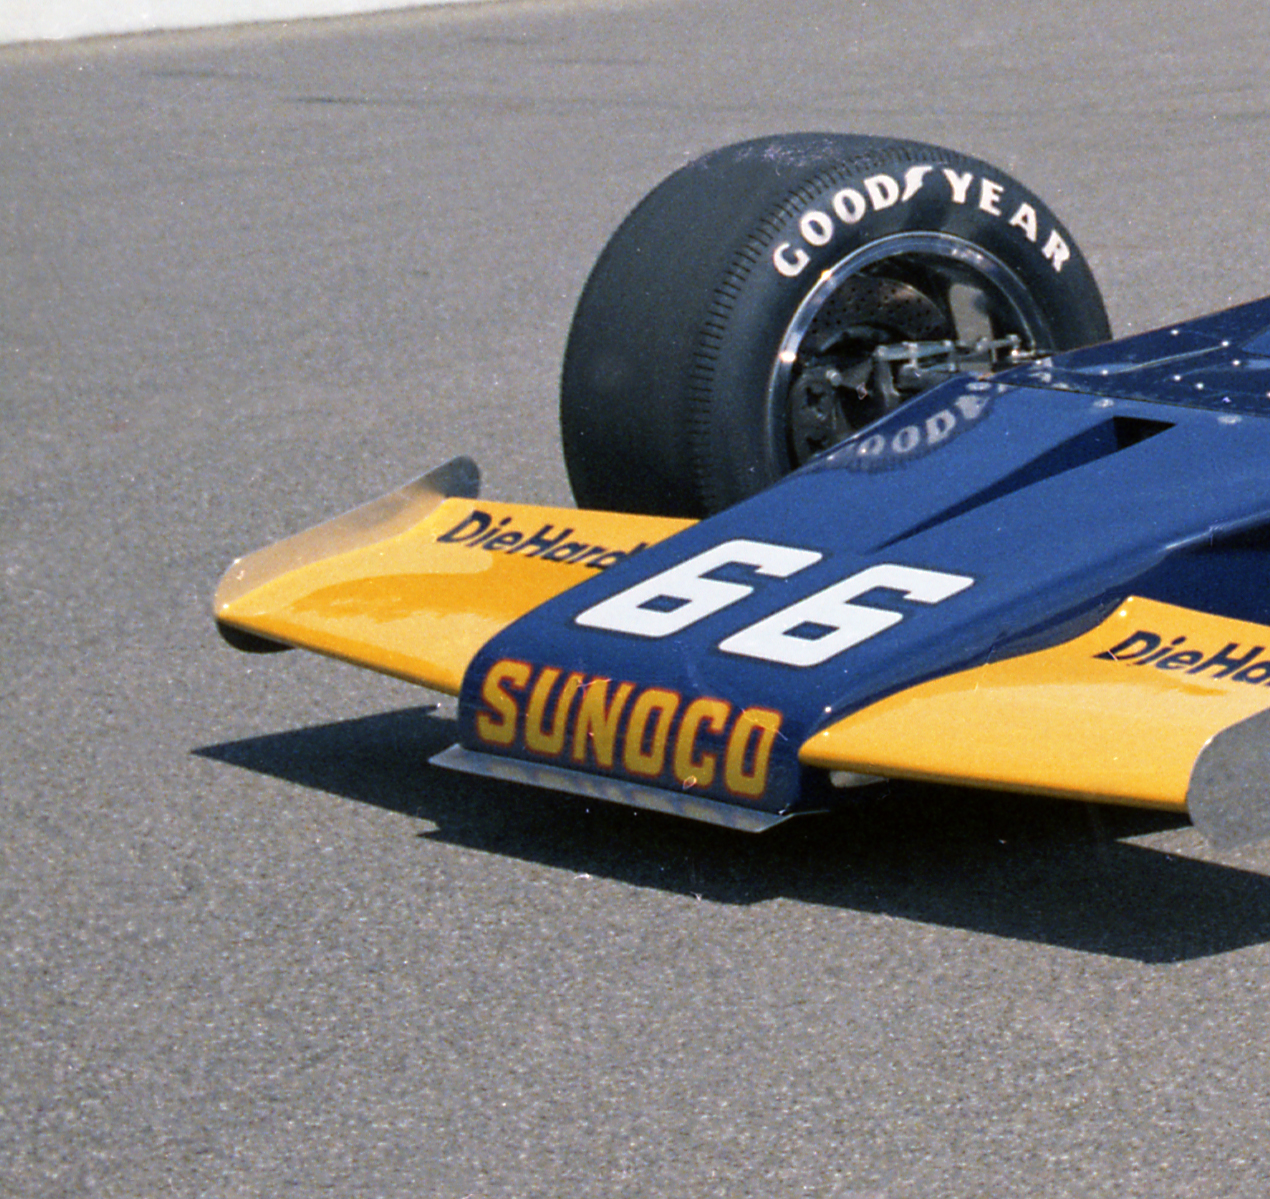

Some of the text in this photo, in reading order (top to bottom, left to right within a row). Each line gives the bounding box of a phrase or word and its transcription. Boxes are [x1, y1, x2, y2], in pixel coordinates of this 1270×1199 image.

[772, 165, 1071, 278] GOODYEAR
[574, 538, 976, 668] 66
[474, 657, 785, 799] SUNOCO
